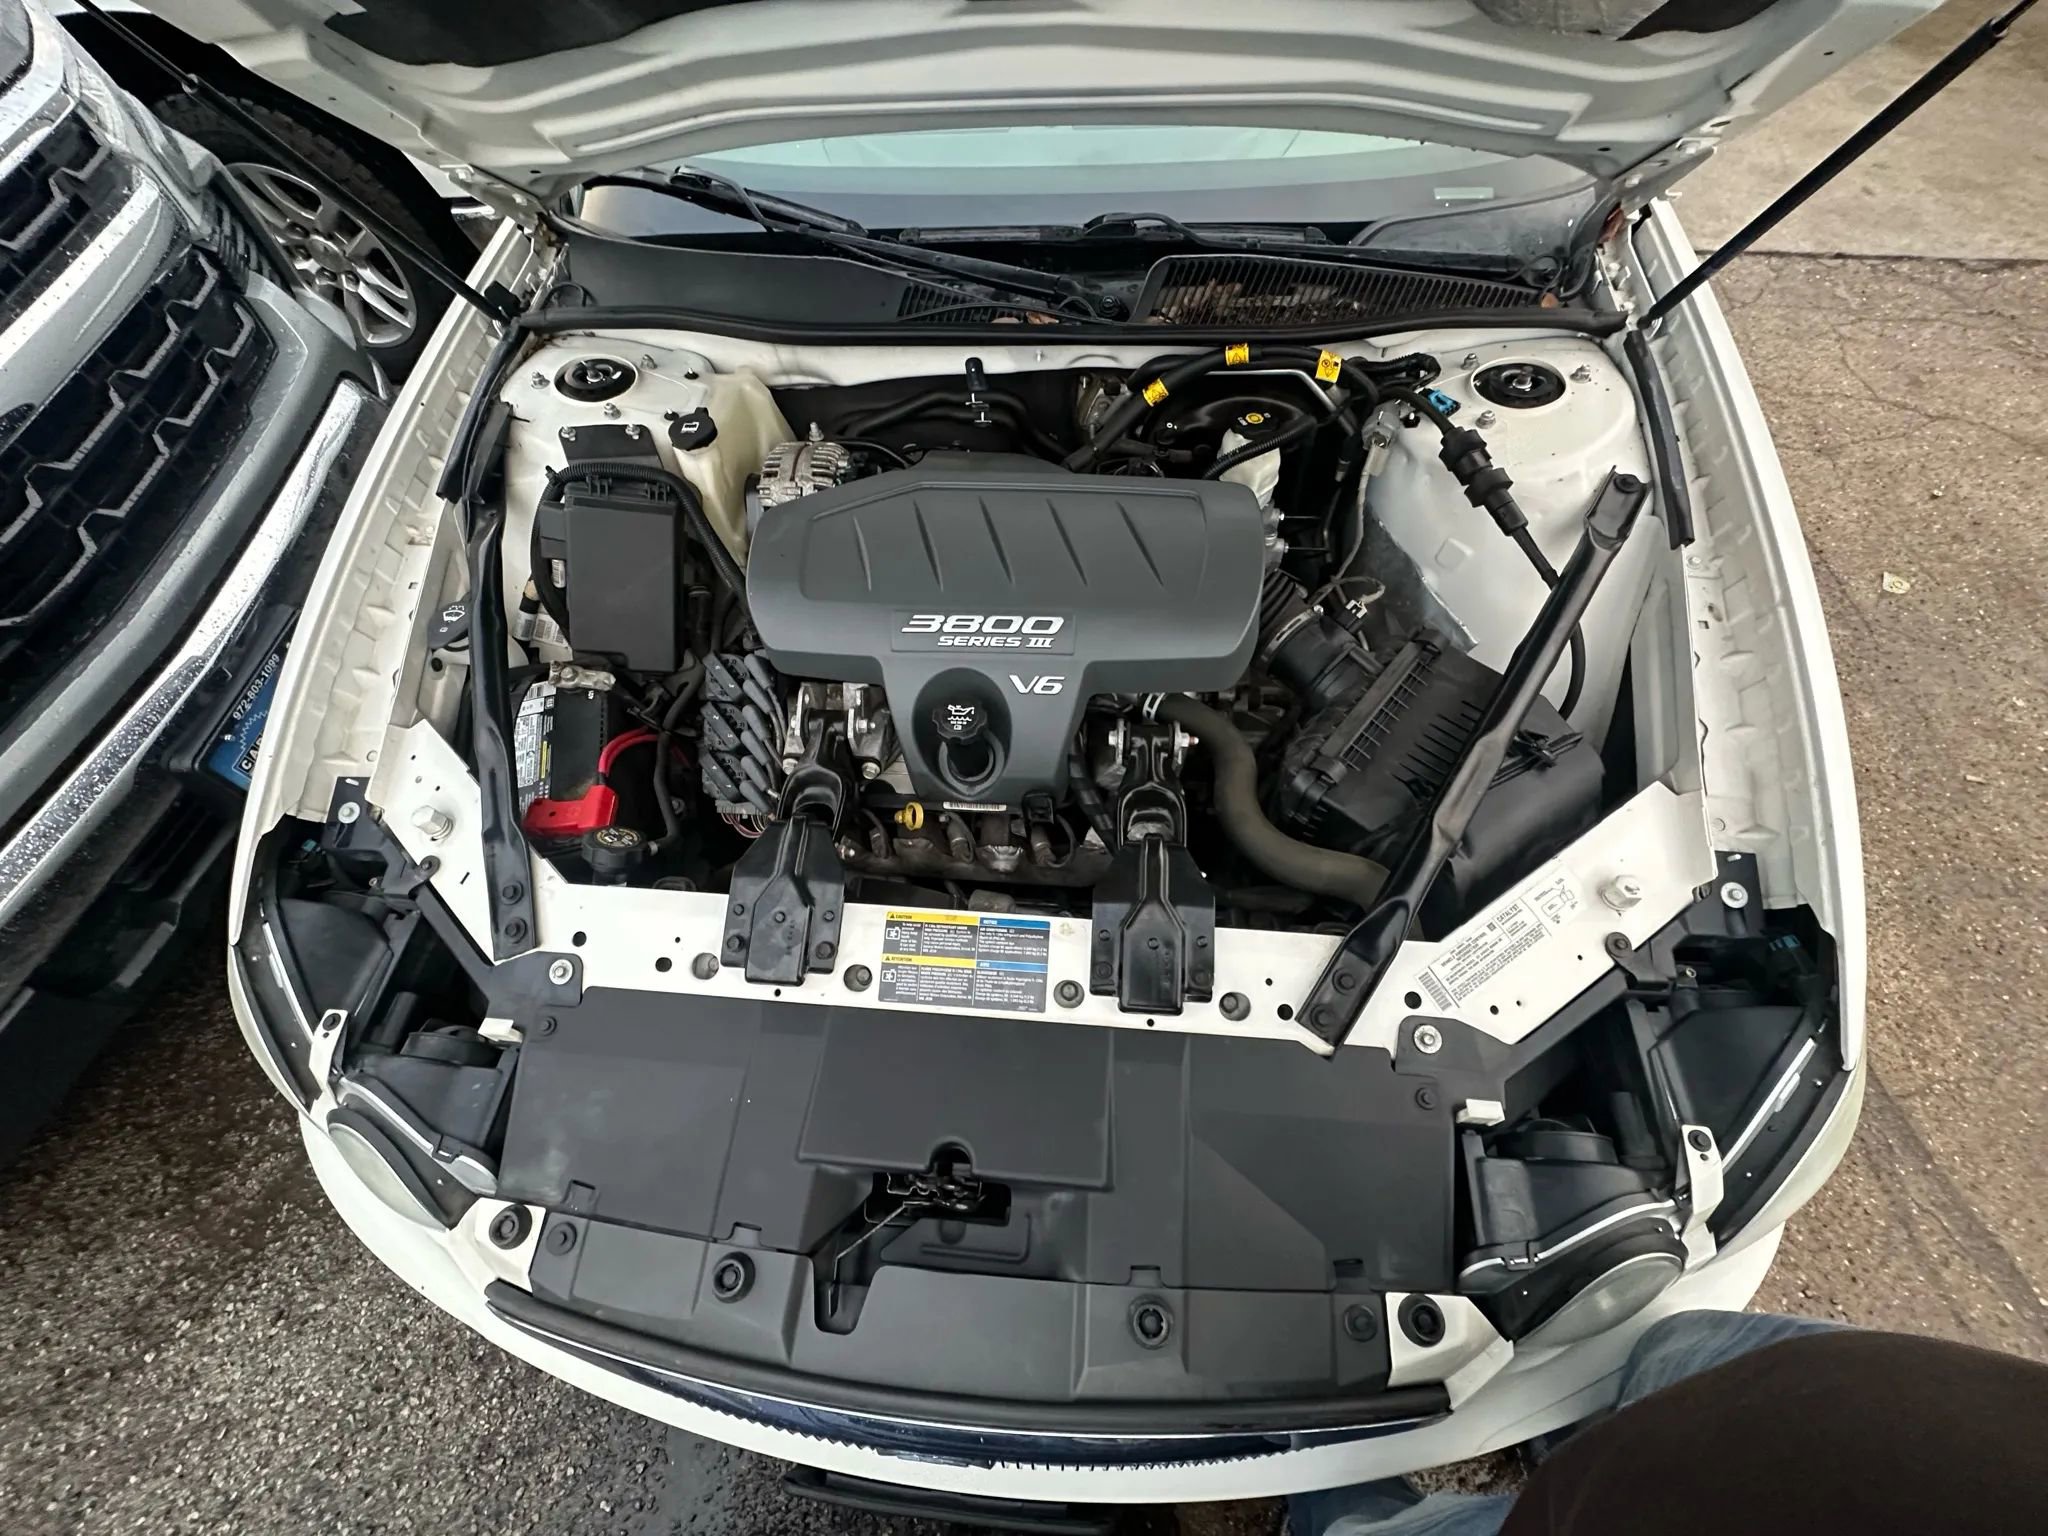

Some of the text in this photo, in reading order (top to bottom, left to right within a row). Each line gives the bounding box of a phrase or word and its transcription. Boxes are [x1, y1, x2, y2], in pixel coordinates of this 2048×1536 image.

[901, 614, 1065, 635] 3800
[937, 635, 1055, 648] SERIES III
[1009, 674, 1065, 695] V6
[1496, 904, 1520, 922] CATALYST
